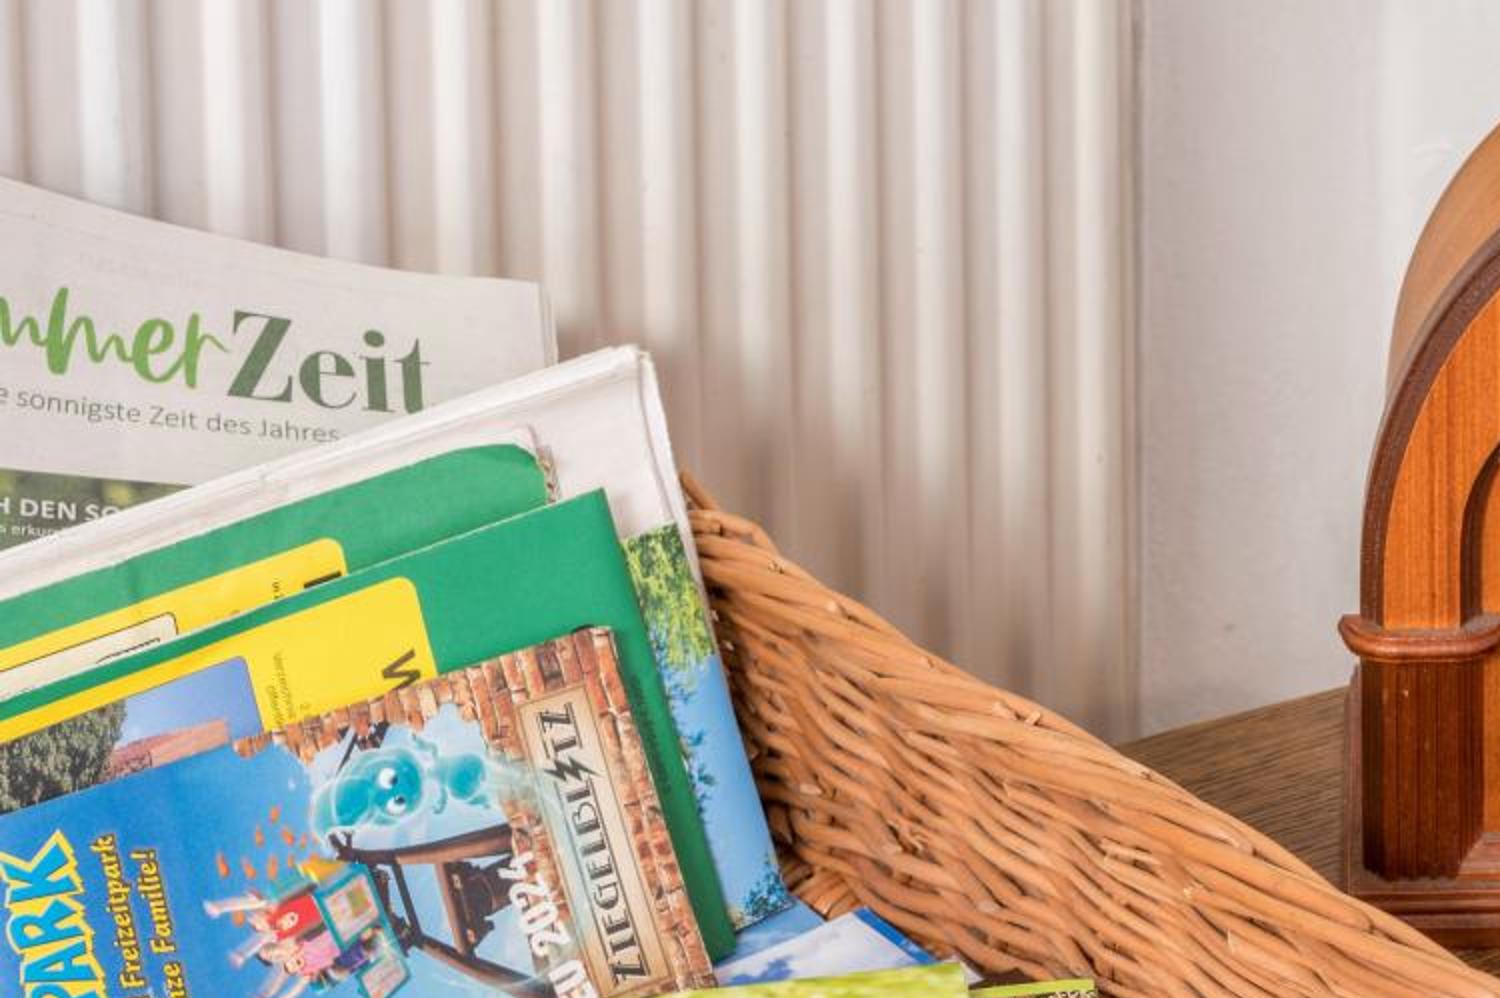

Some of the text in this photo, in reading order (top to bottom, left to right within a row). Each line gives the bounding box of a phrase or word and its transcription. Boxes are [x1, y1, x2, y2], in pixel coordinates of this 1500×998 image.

[16, 390, 141, 423] sonnigste
[149, 405, 199, 430] Zeit
[206, 413, 250, 433] des
[258, 418, 341, 443] Jahres
[20, 498, 77, 521] DEN
[90, 832, 146, 990] Freizeitpark
[130, 847, 178, 957] Familie!
[498, 850, 573, 957] 2024
